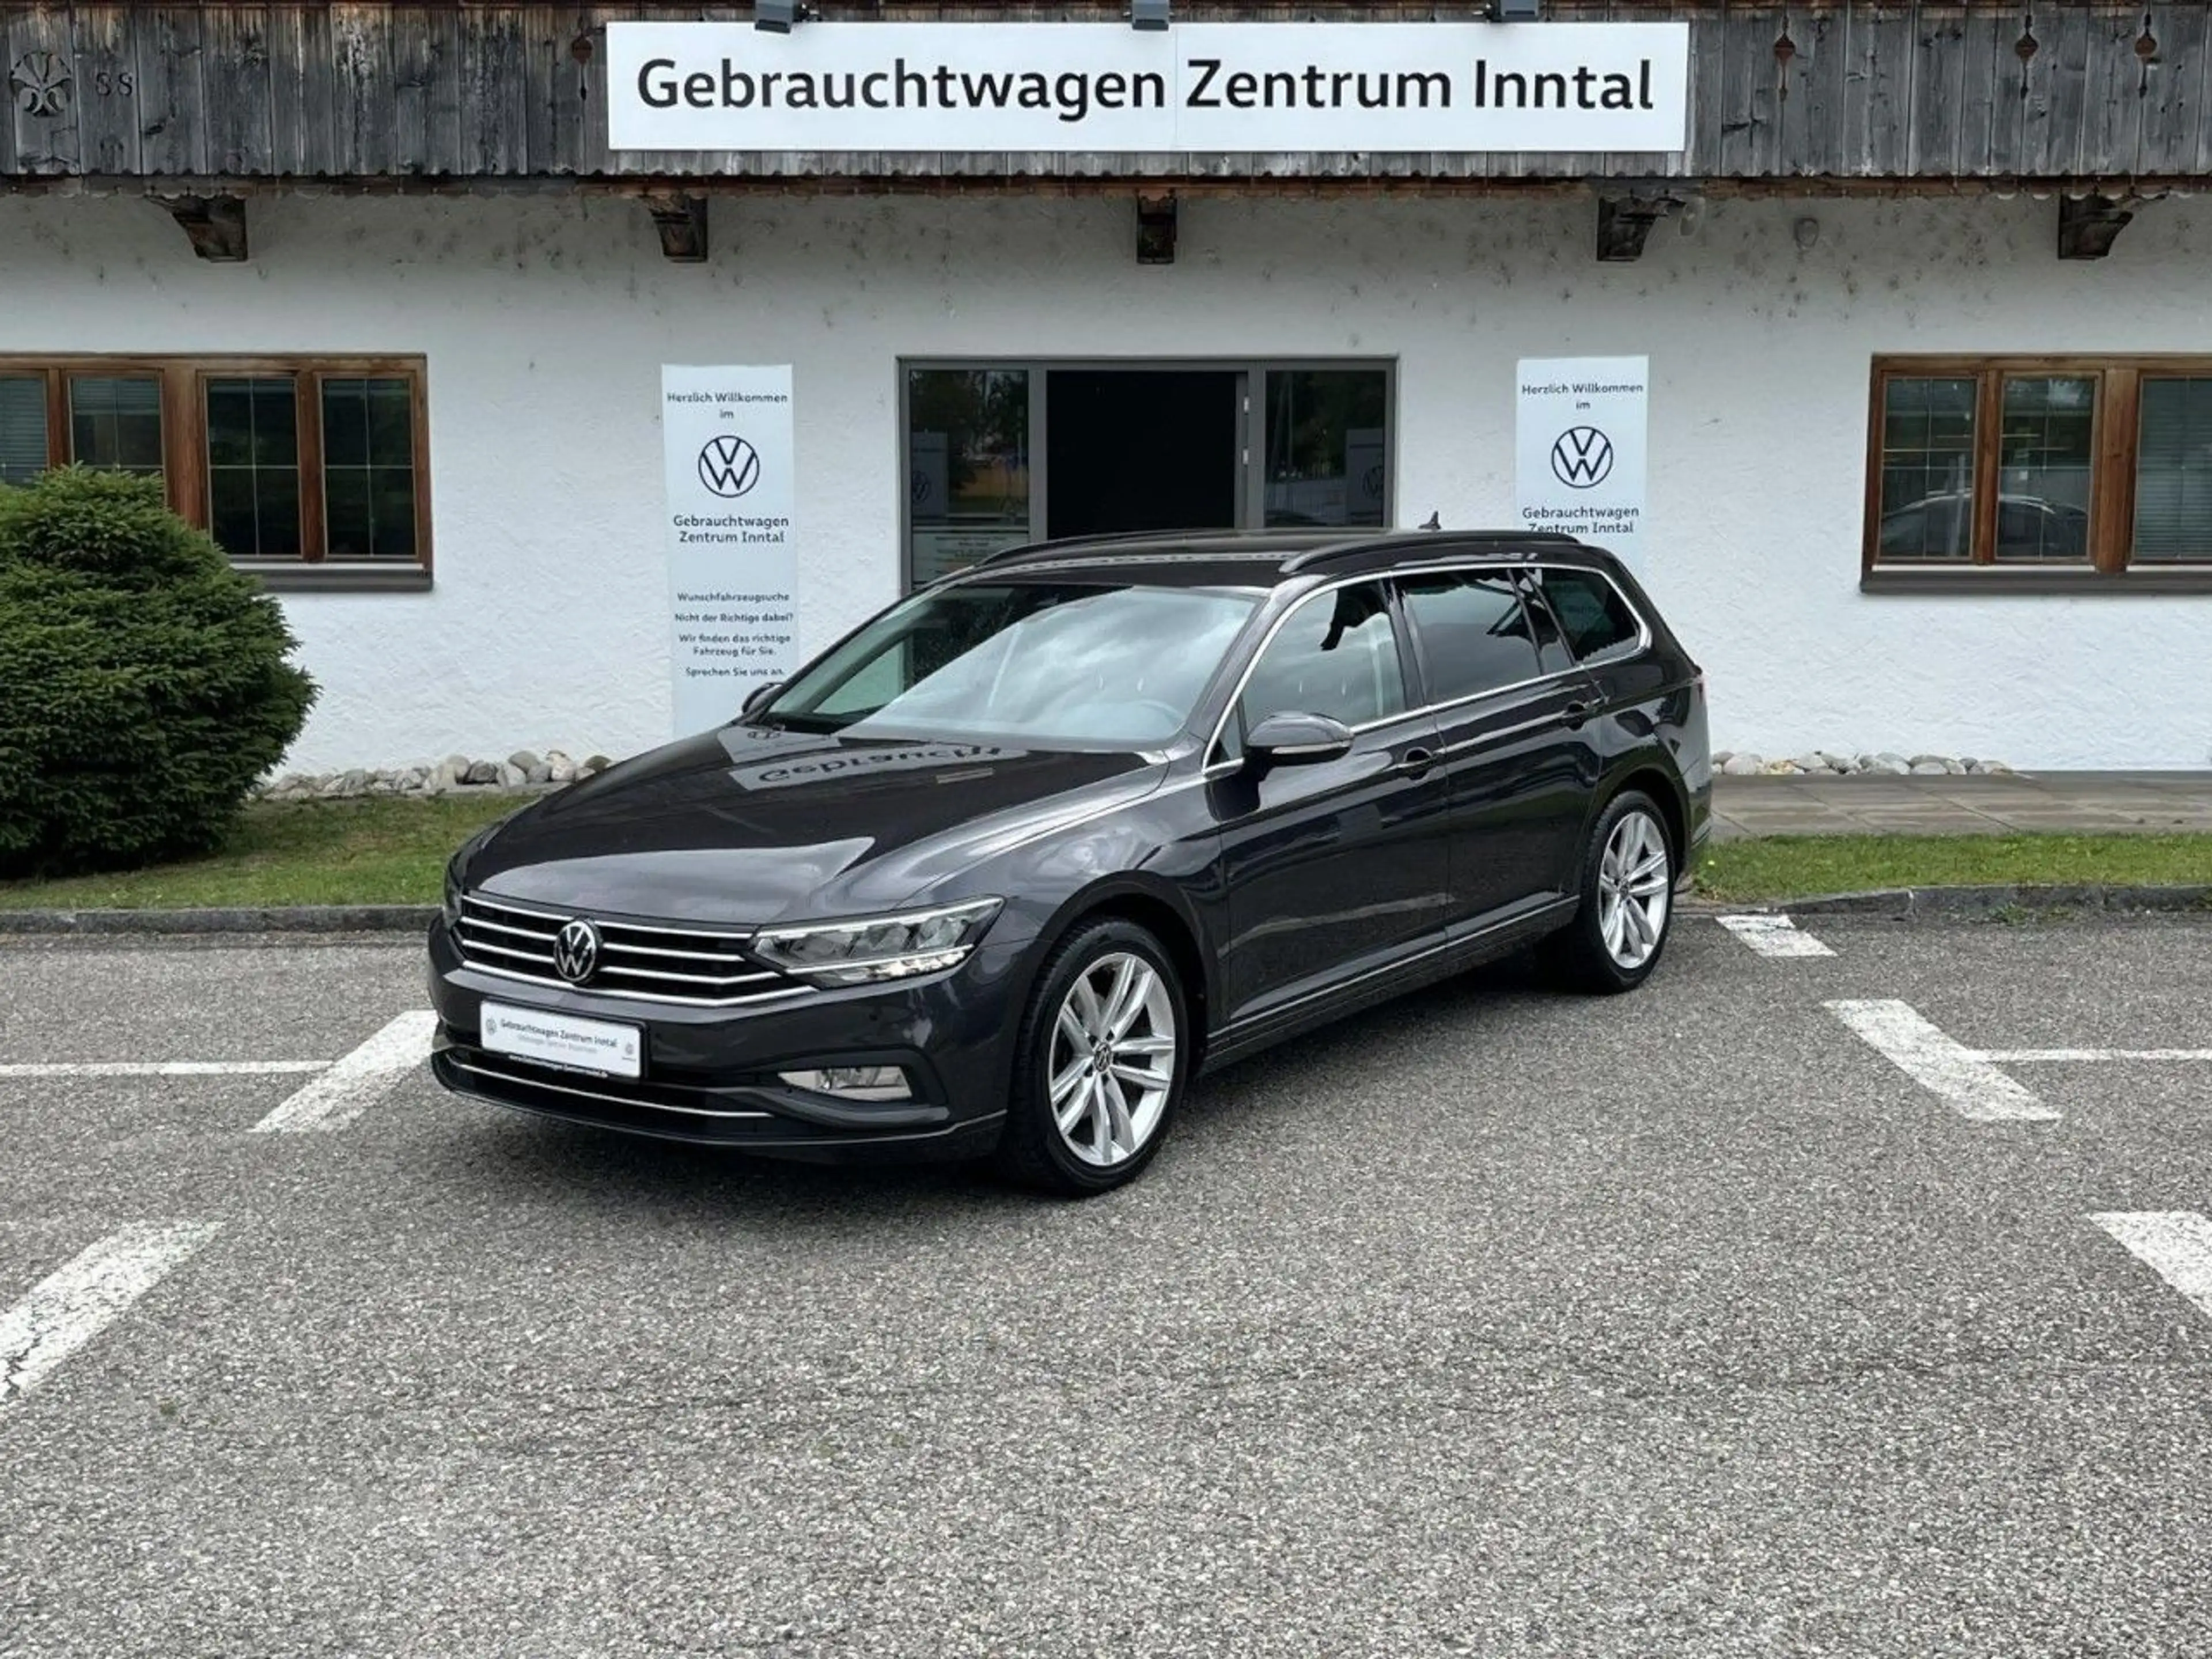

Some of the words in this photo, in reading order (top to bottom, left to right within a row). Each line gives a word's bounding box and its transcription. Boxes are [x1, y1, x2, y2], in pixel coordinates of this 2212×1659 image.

[638, 58, 1164, 122] Gebrauchtwagen
[1187, 59, 1450, 108] Zentrum
[1476, 59, 1653, 109] Inntal
[1522, 384, 1569, 394] Herzlich
[1573, 383, 1643, 393] Willkommen
[667, 392, 712, 403] Herzlich
[715, 392, 787, 403] Willkommen
[1576, 401, 1590, 410] im
[720, 410, 734, 419] im
[1522, 506, 1639, 521] Gebrauchtwagen
[673, 515, 789, 529] Gebrauchtwagen
[1528, 522, 1588, 533] Zentrum
[1593, 522, 1633, 533] Inntal
[680, 531, 737, 543] Zentrum
[742, 531, 784, 543] Inntal
[677, 593, 789, 604] Wunschfahrzeugsuche
[675, 613, 699, 622] Nicht
[702, 613, 717, 622] der
[721, 613, 759, 624] Richtige
[762, 613, 793, 622] dabei?
[679, 634, 696, 642] Wir
[733, 634, 749, 643] das
[752, 634, 790, 644] richtige
[694, 646, 738, 657] Fahrzeug
[741, 646, 756, 656] für
[686, 667, 730, 677] Sprechen
[733, 667, 747, 676] Sie
